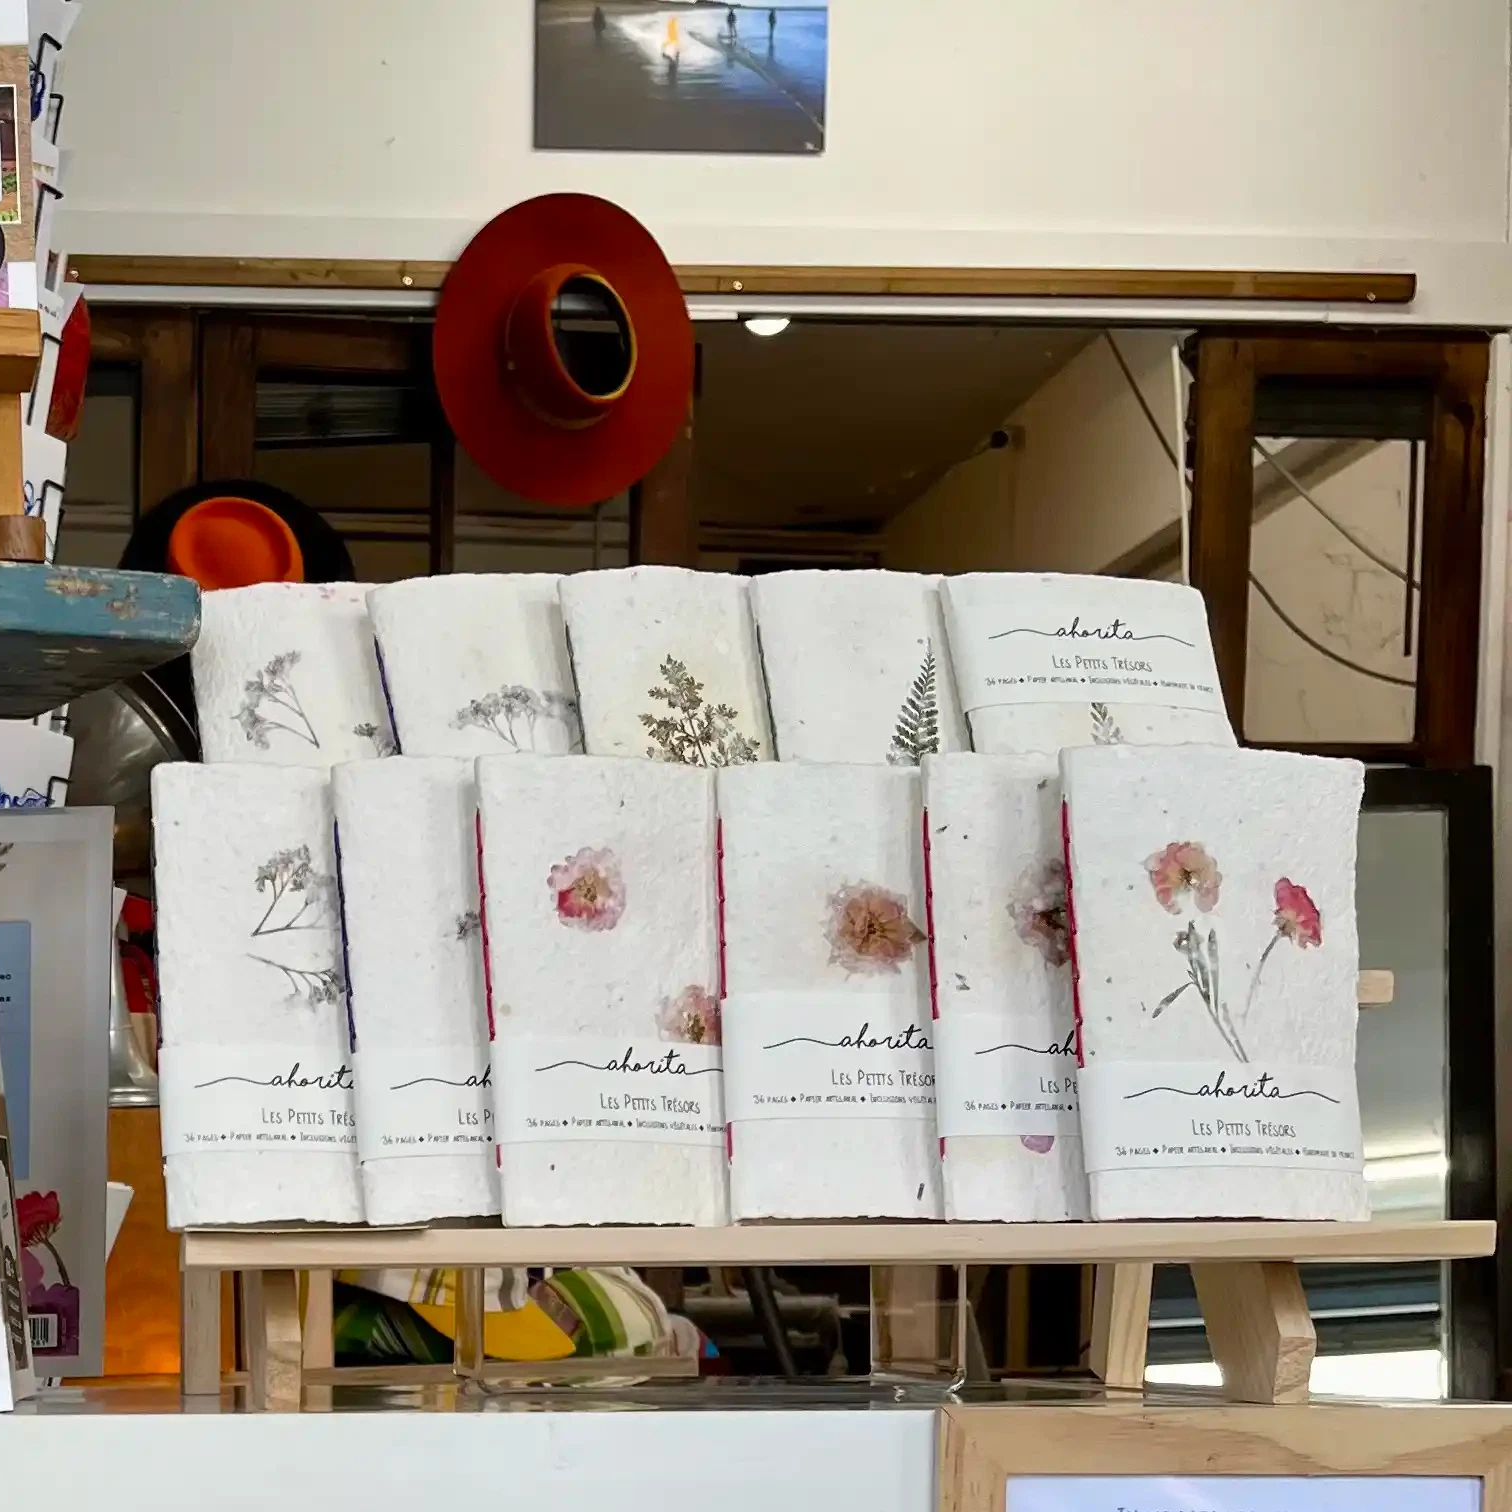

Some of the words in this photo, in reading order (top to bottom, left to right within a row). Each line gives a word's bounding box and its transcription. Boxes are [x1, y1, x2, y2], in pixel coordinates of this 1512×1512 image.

[839, 1022, 934, 1050] ahorita
[605, 1046, 690, 1076] ahorita
[1198, 1070, 1282, 1099] ahorita
